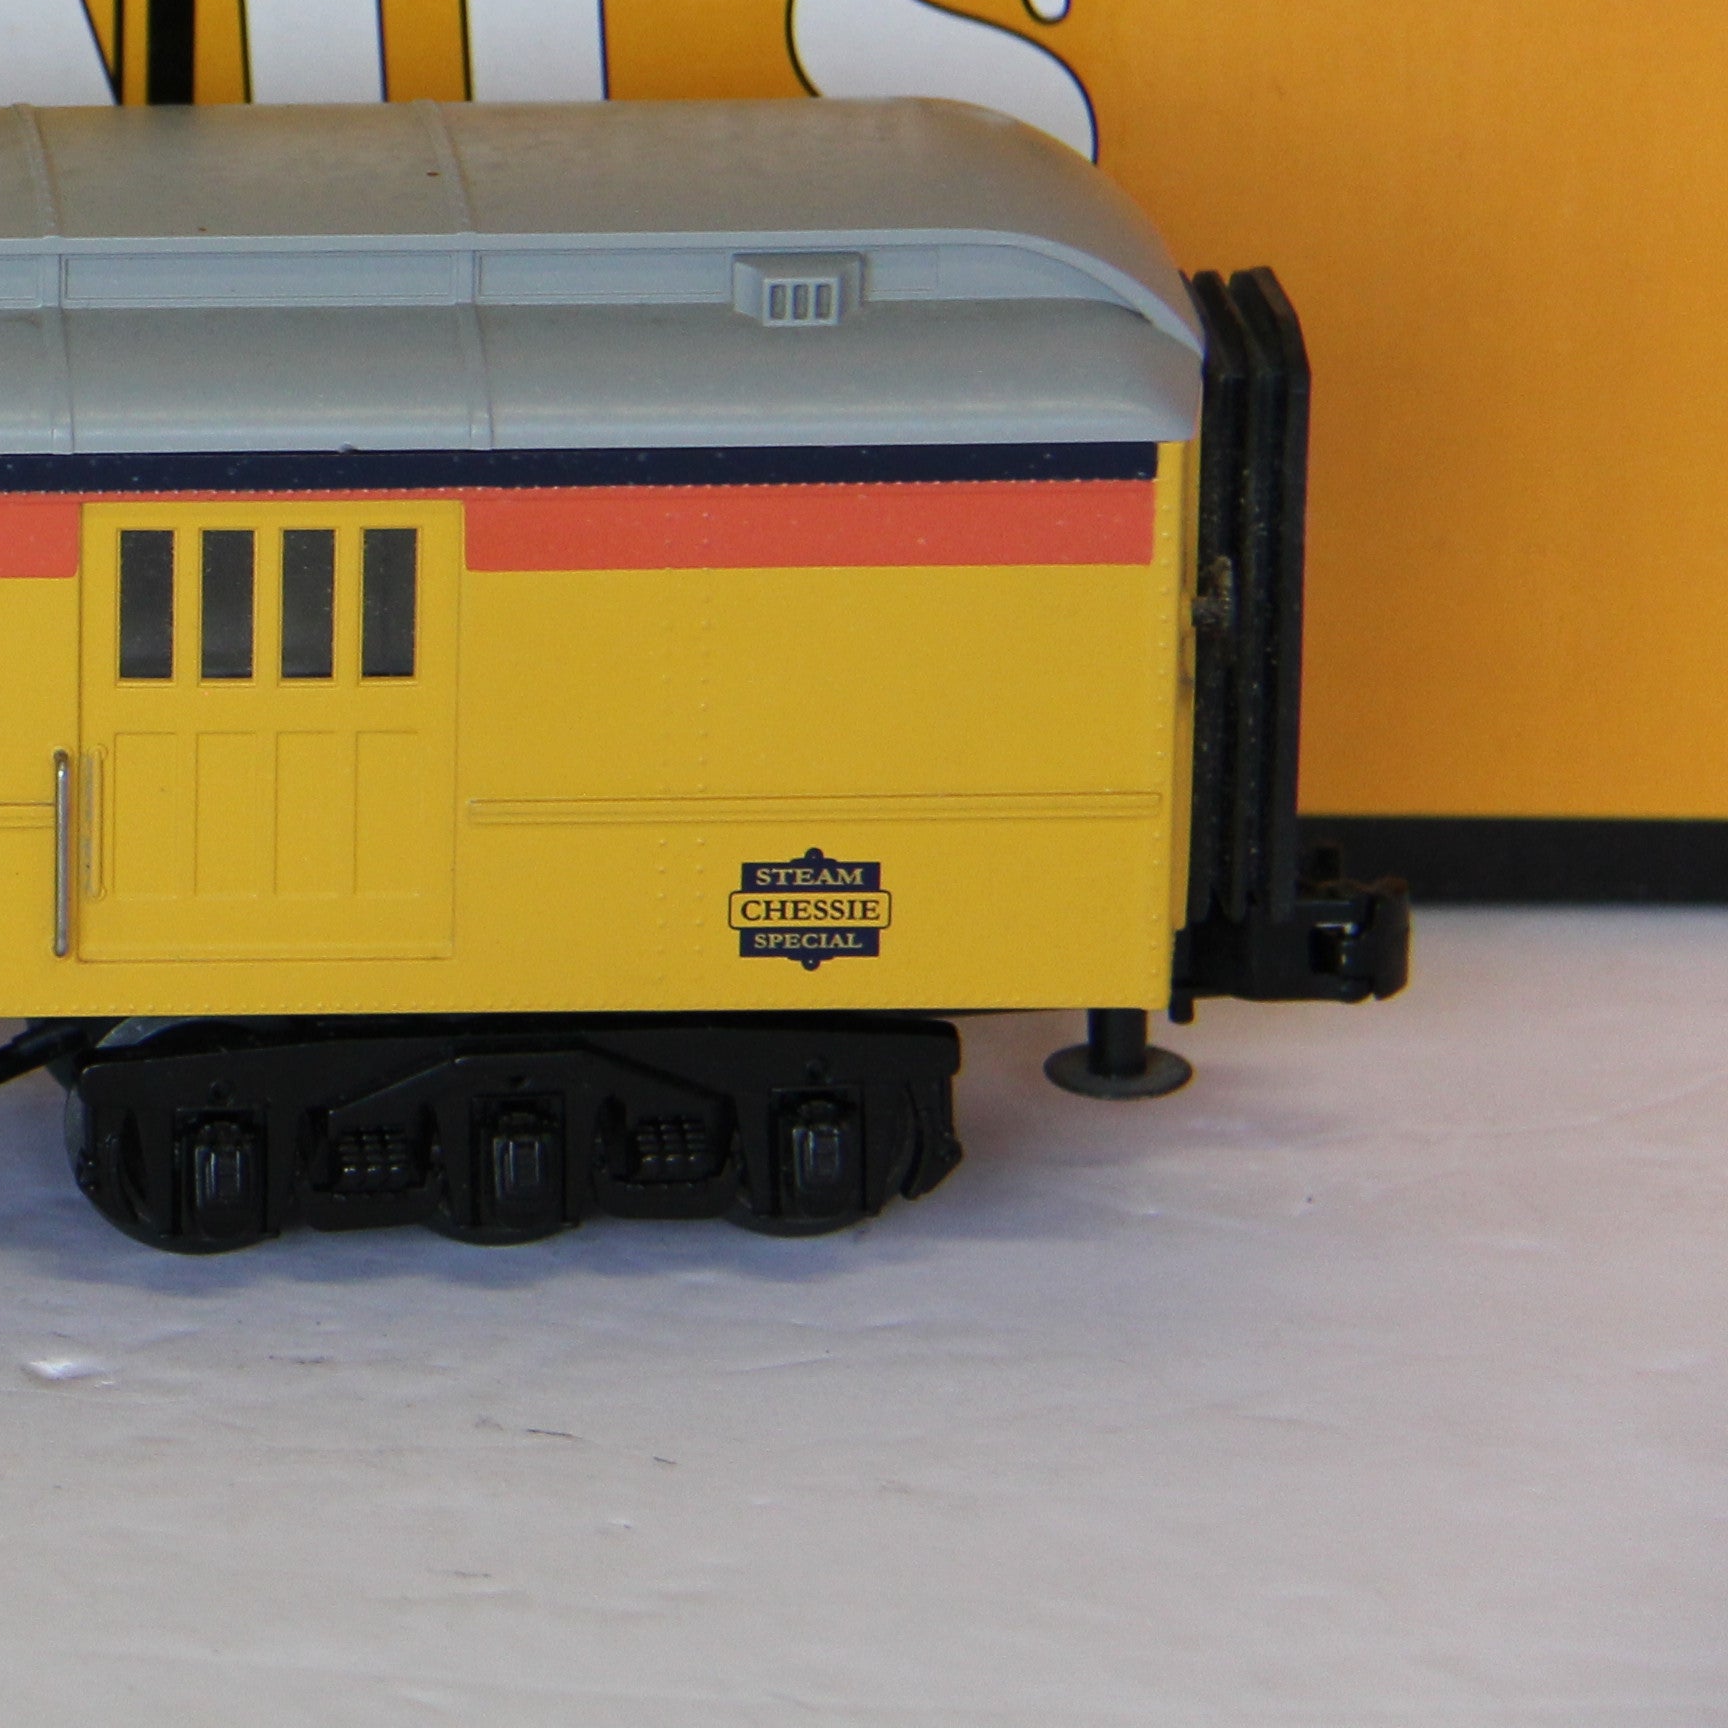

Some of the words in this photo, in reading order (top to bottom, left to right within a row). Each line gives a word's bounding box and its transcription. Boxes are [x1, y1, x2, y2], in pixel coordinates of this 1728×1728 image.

[755, 868, 865, 886] STEAM
[741, 899, 881, 921] CHESSIE
[753, 932, 863, 950] SPECIAL
